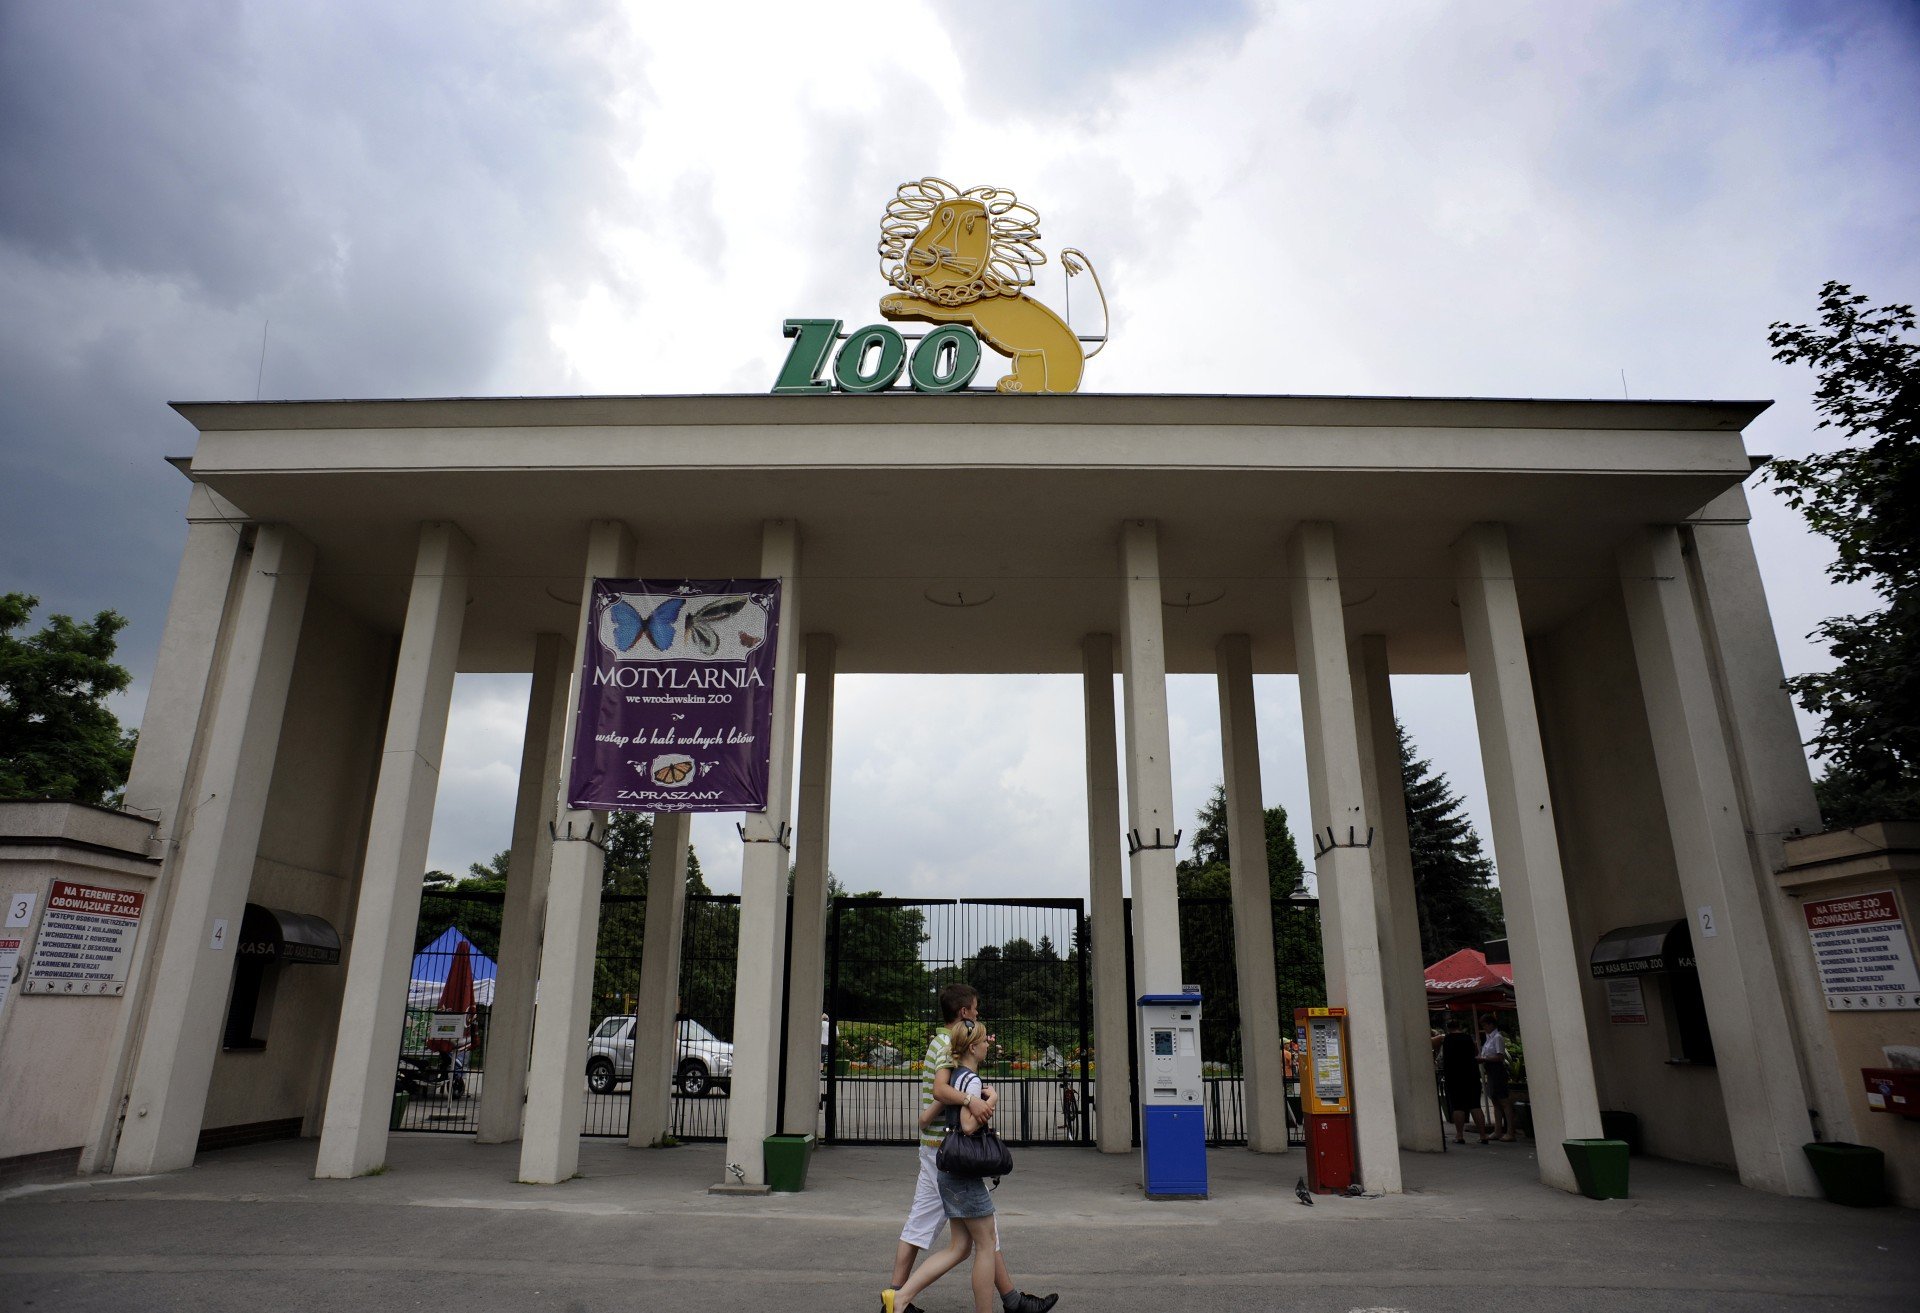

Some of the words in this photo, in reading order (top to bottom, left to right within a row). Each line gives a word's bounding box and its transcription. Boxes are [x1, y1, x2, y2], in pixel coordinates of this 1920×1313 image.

[592, 666, 764, 688] MOTYLARNIA
[643, 694, 706, 704] wrocławskim
[708, 694, 732, 704] ZOO
[596, 729, 629, 748] wstąp
[632, 728, 647, 744] do
[650, 727, 674, 744] hali
[678, 728, 723, 749] wolnych
[726, 727, 755, 744] lotów
[617, 790, 724, 800] ZAPRASZAMY
[64, 886, 76, 896] NA
[80, 888, 116, 900] TERENIE
[118, 894, 135, 904] ZOO
[15, 902, 28, 919] 3
[52, 897, 111, 912] OBOWIĄZUJE
[112, 904, 140, 916] ZAKAZ
[1816, 906, 1828, 914] NA
[1828, 902, 1861, 913] TERENIE
[1862, 898, 1880, 909] ZOO
[76, 915, 99, 923] OSOBOM
[1703, 914, 1712, 929] 2
[1812, 912, 1862, 925] OBOWIĄZUJE
[1863, 908, 1892, 920] ZAKAZ
[48, 922, 86, 931] WCHODZENIA
[214, 926, 222, 941] 4
[45, 932, 83, 941] WCHODZENIA
[42, 941, 81, 950] WCHODZENIA
[40, 951, 78, 959] WCHODZENIA
[1678, 957, 1696, 967] KAS
[1593, 966, 1604, 975] ZOO
[1606, 963, 1620, 973] KASA
[1621, 960, 1649, 971] BILETOWA
[1650, 958, 1663, 968] ZOO
[34, 970, 84, 979] WPROWADZANIA
